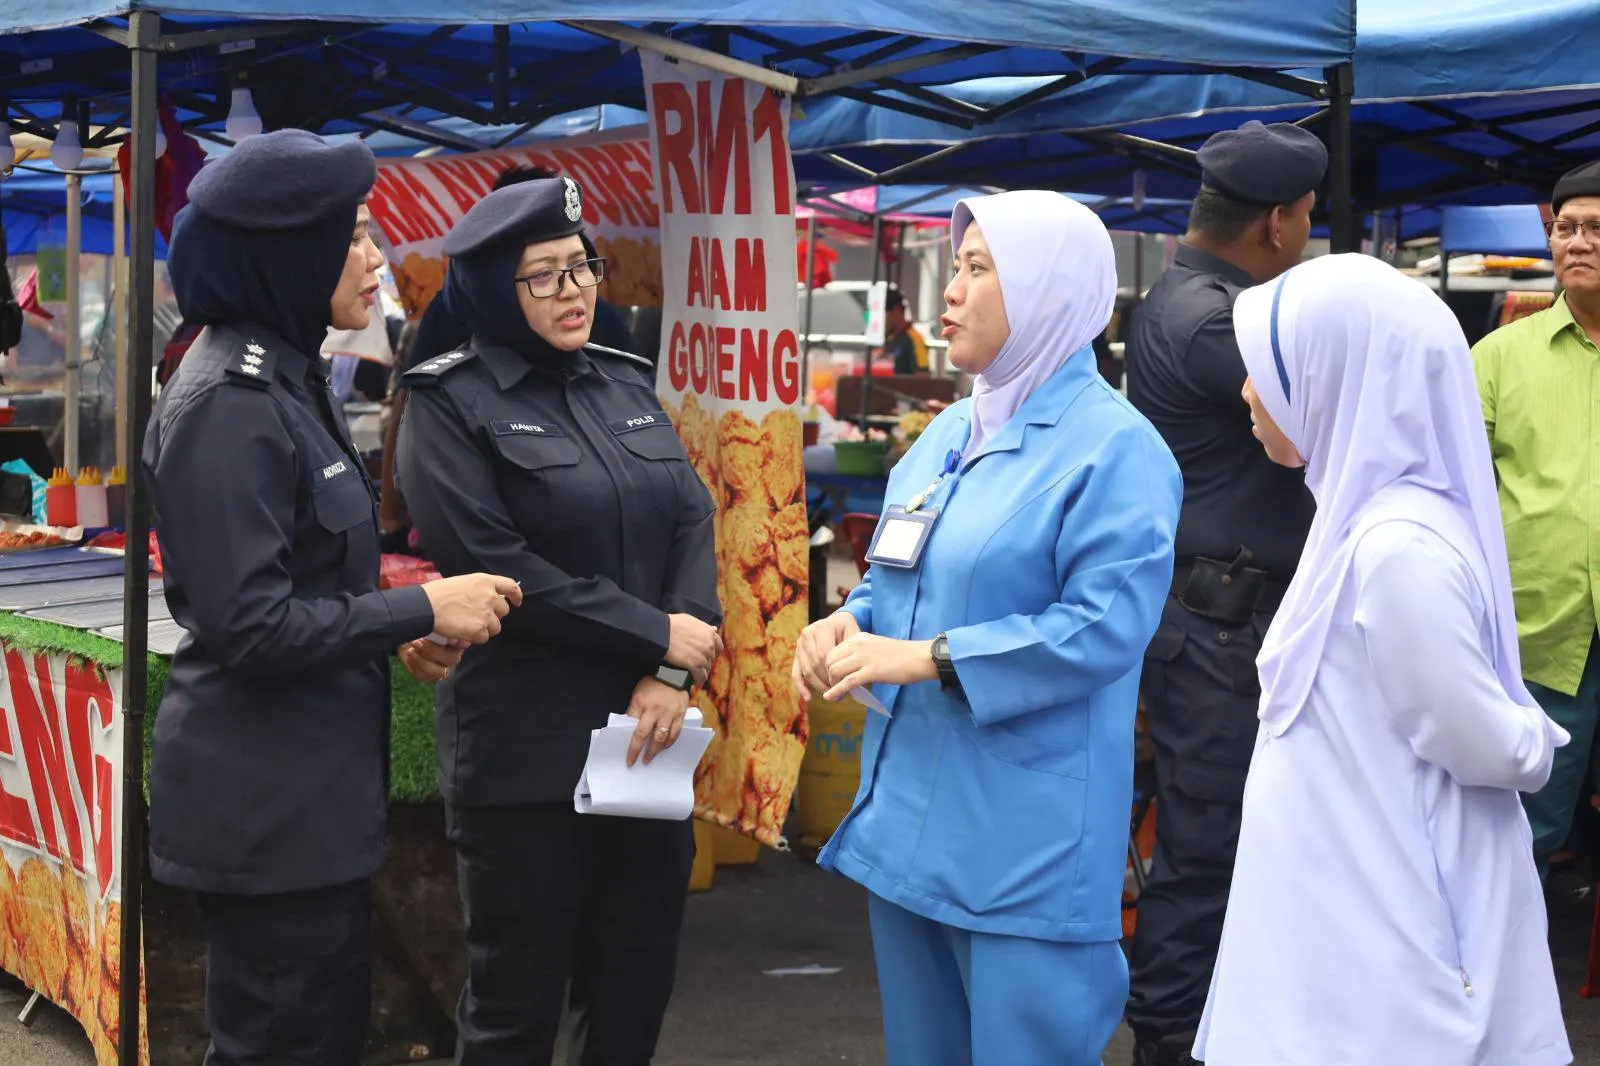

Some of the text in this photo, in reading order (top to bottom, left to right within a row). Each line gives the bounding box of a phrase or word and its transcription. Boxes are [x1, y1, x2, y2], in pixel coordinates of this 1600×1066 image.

[653, 78, 791, 215] RM1
[366, 164, 454, 246] RM1
[525, 140, 660, 227] ORE
[669, 320, 799, 405] GORENG
[510, 423, 546, 433] HANITA
[626, 415, 655, 428] POLIS
